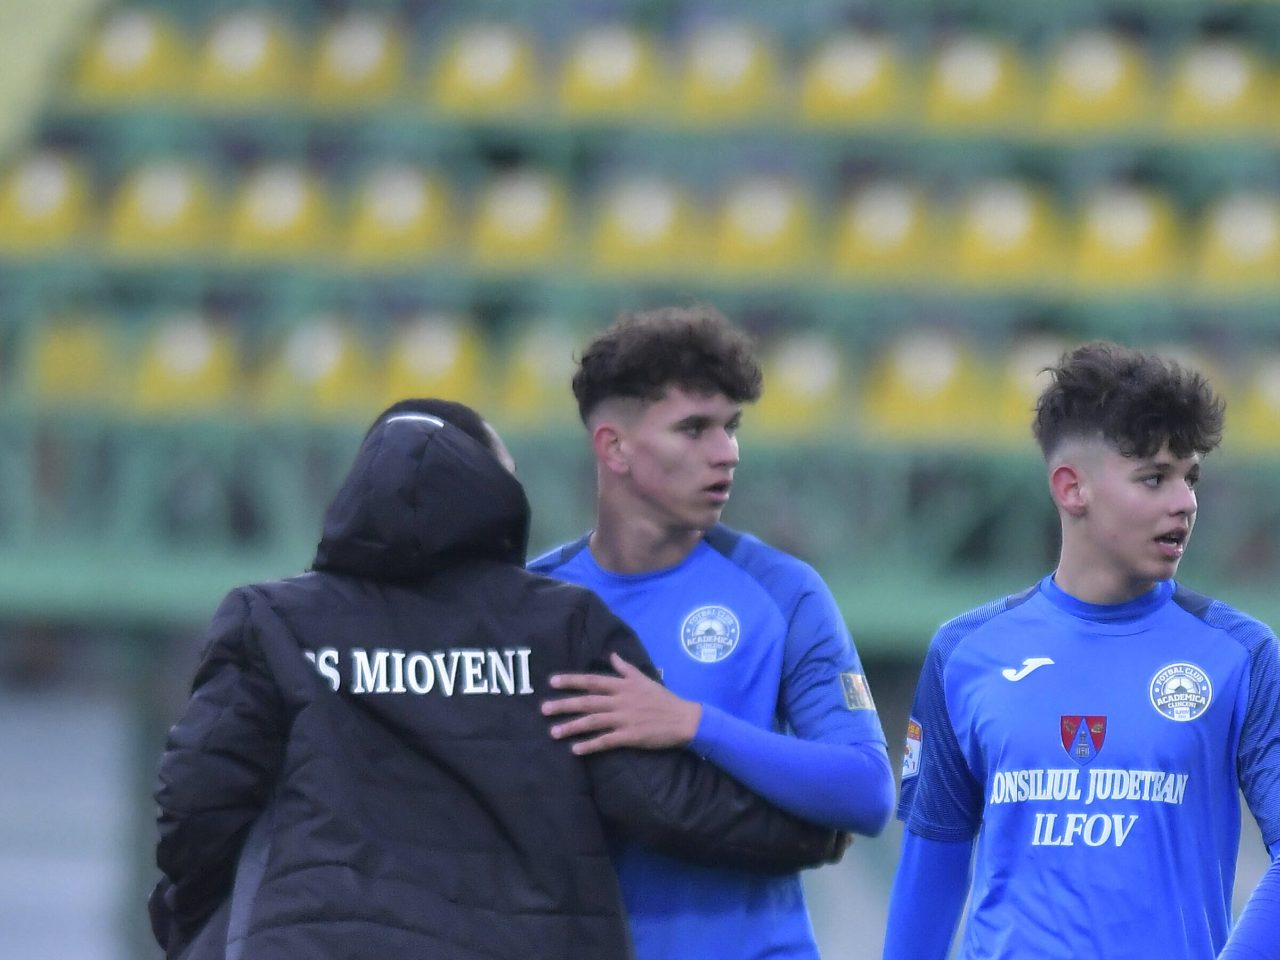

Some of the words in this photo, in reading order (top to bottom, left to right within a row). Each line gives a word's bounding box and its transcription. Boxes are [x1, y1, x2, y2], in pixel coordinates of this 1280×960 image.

[304, 648, 341, 692] S
[353, 648, 534, 696] MIOVENI
[1156, 667, 1184, 685] FOTBAL
[1185, 667, 1204, 683] CLUB
[1157, 693, 1206, 706] ACADEMICA
[989, 769, 1081, 805] ONSILIUL
[1084, 769, 1189, 805] JUDETEAN
[1031, 813, 1139, 847] ILFOV
